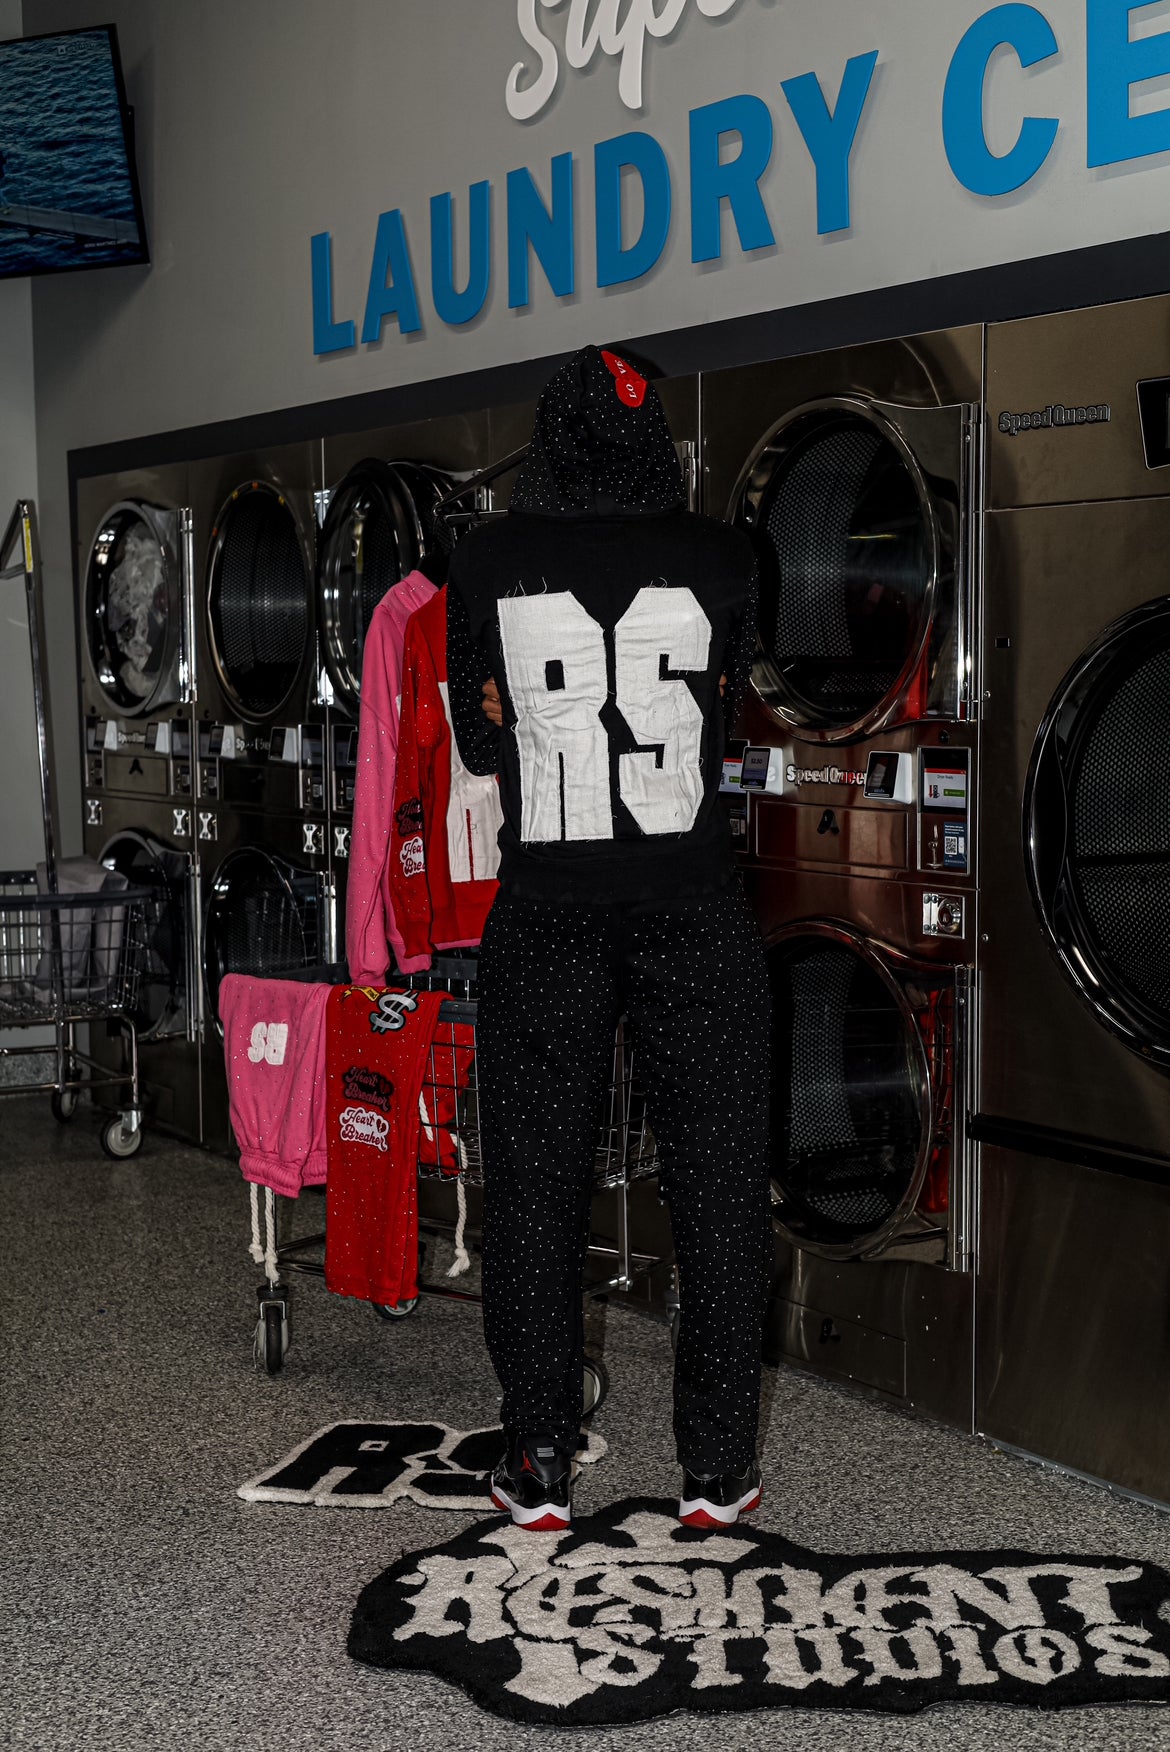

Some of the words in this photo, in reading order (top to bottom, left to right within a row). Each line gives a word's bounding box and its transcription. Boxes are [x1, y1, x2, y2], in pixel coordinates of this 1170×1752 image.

[505, 0, 738, 120] Sup
[311, 50, 879, 355] LAUNDRY
[942, 0, 1170, 196] CE
[497, 586, 712, 842] RS
[345, 1067, 379, 1088] Heart
[345, 1083, 389, 1112] Breaker
[342, 1109, 375, 1131] Heart
[341, 1125, 388, 1151] Breaker
